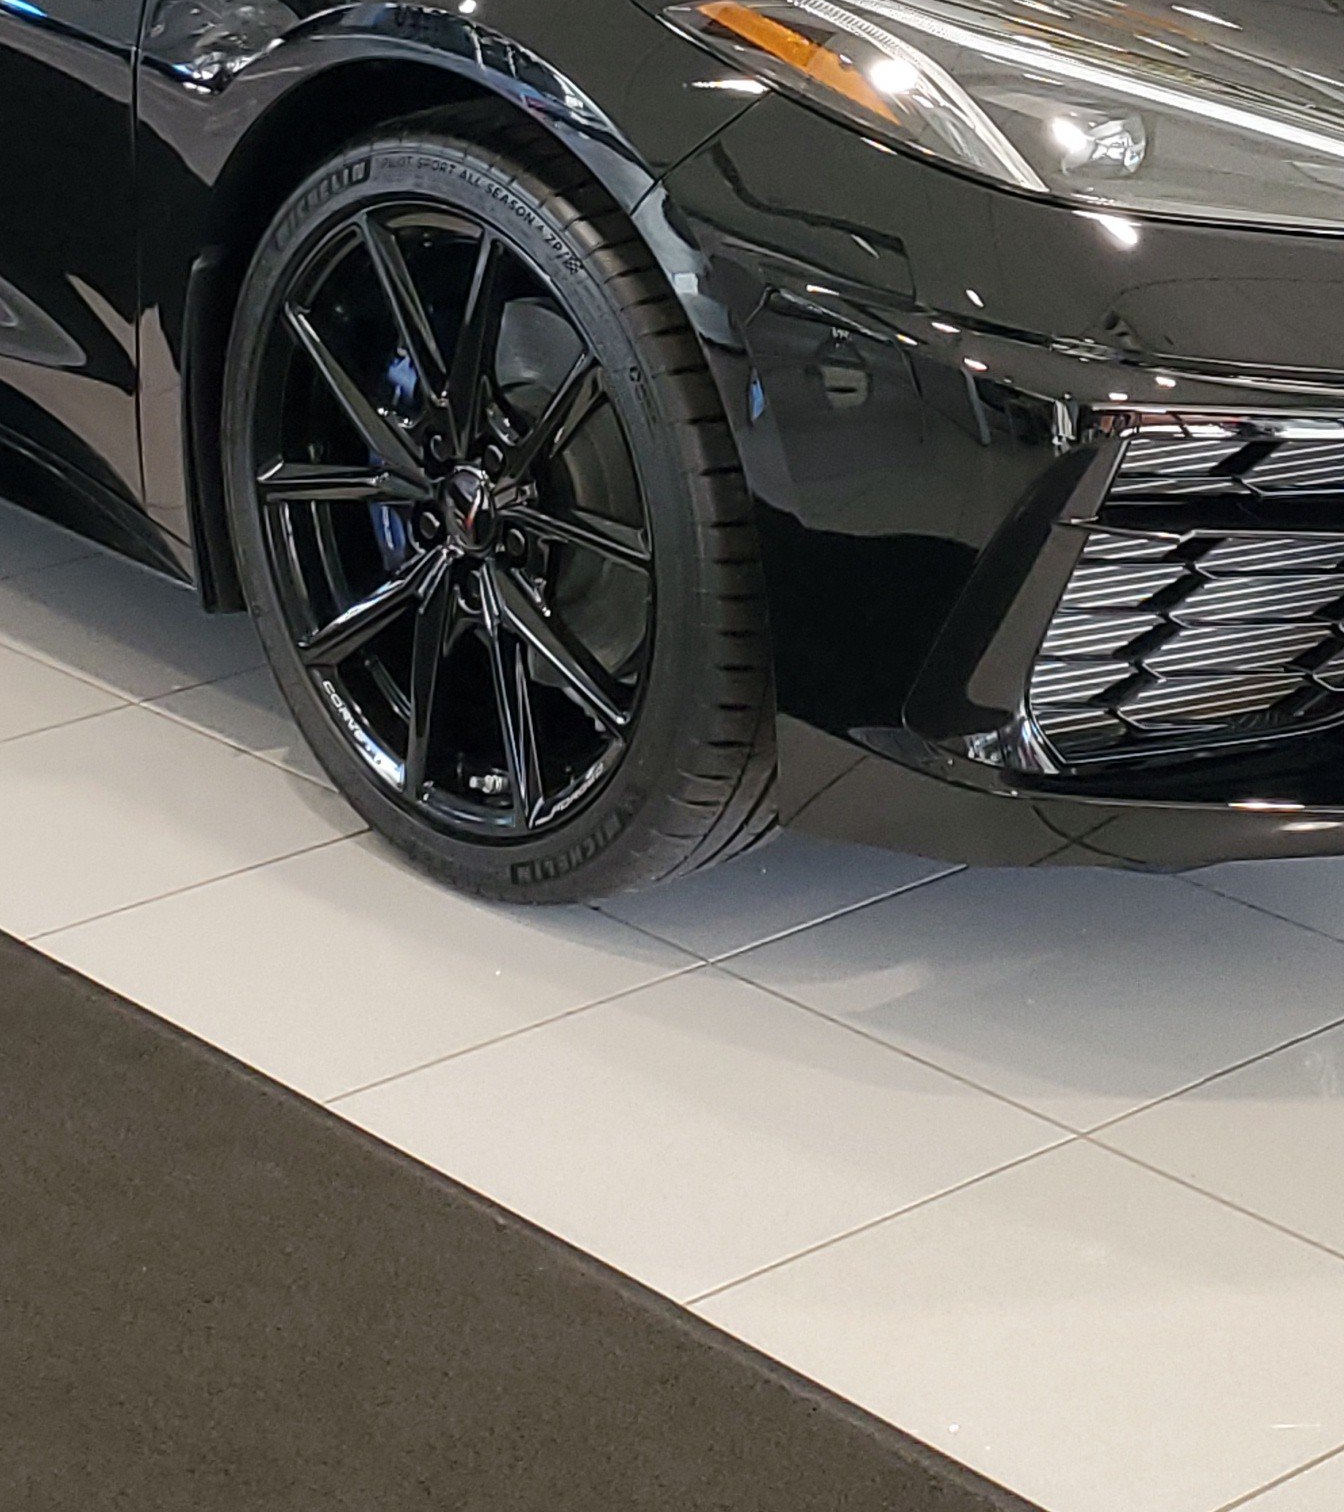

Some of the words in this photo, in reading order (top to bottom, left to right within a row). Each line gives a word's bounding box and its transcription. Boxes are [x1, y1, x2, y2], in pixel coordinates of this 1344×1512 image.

[417, 156, 457, 175] SPORT
[459, 168, 482, 188] ALL
[485, 182, 537, 225] SEASON
